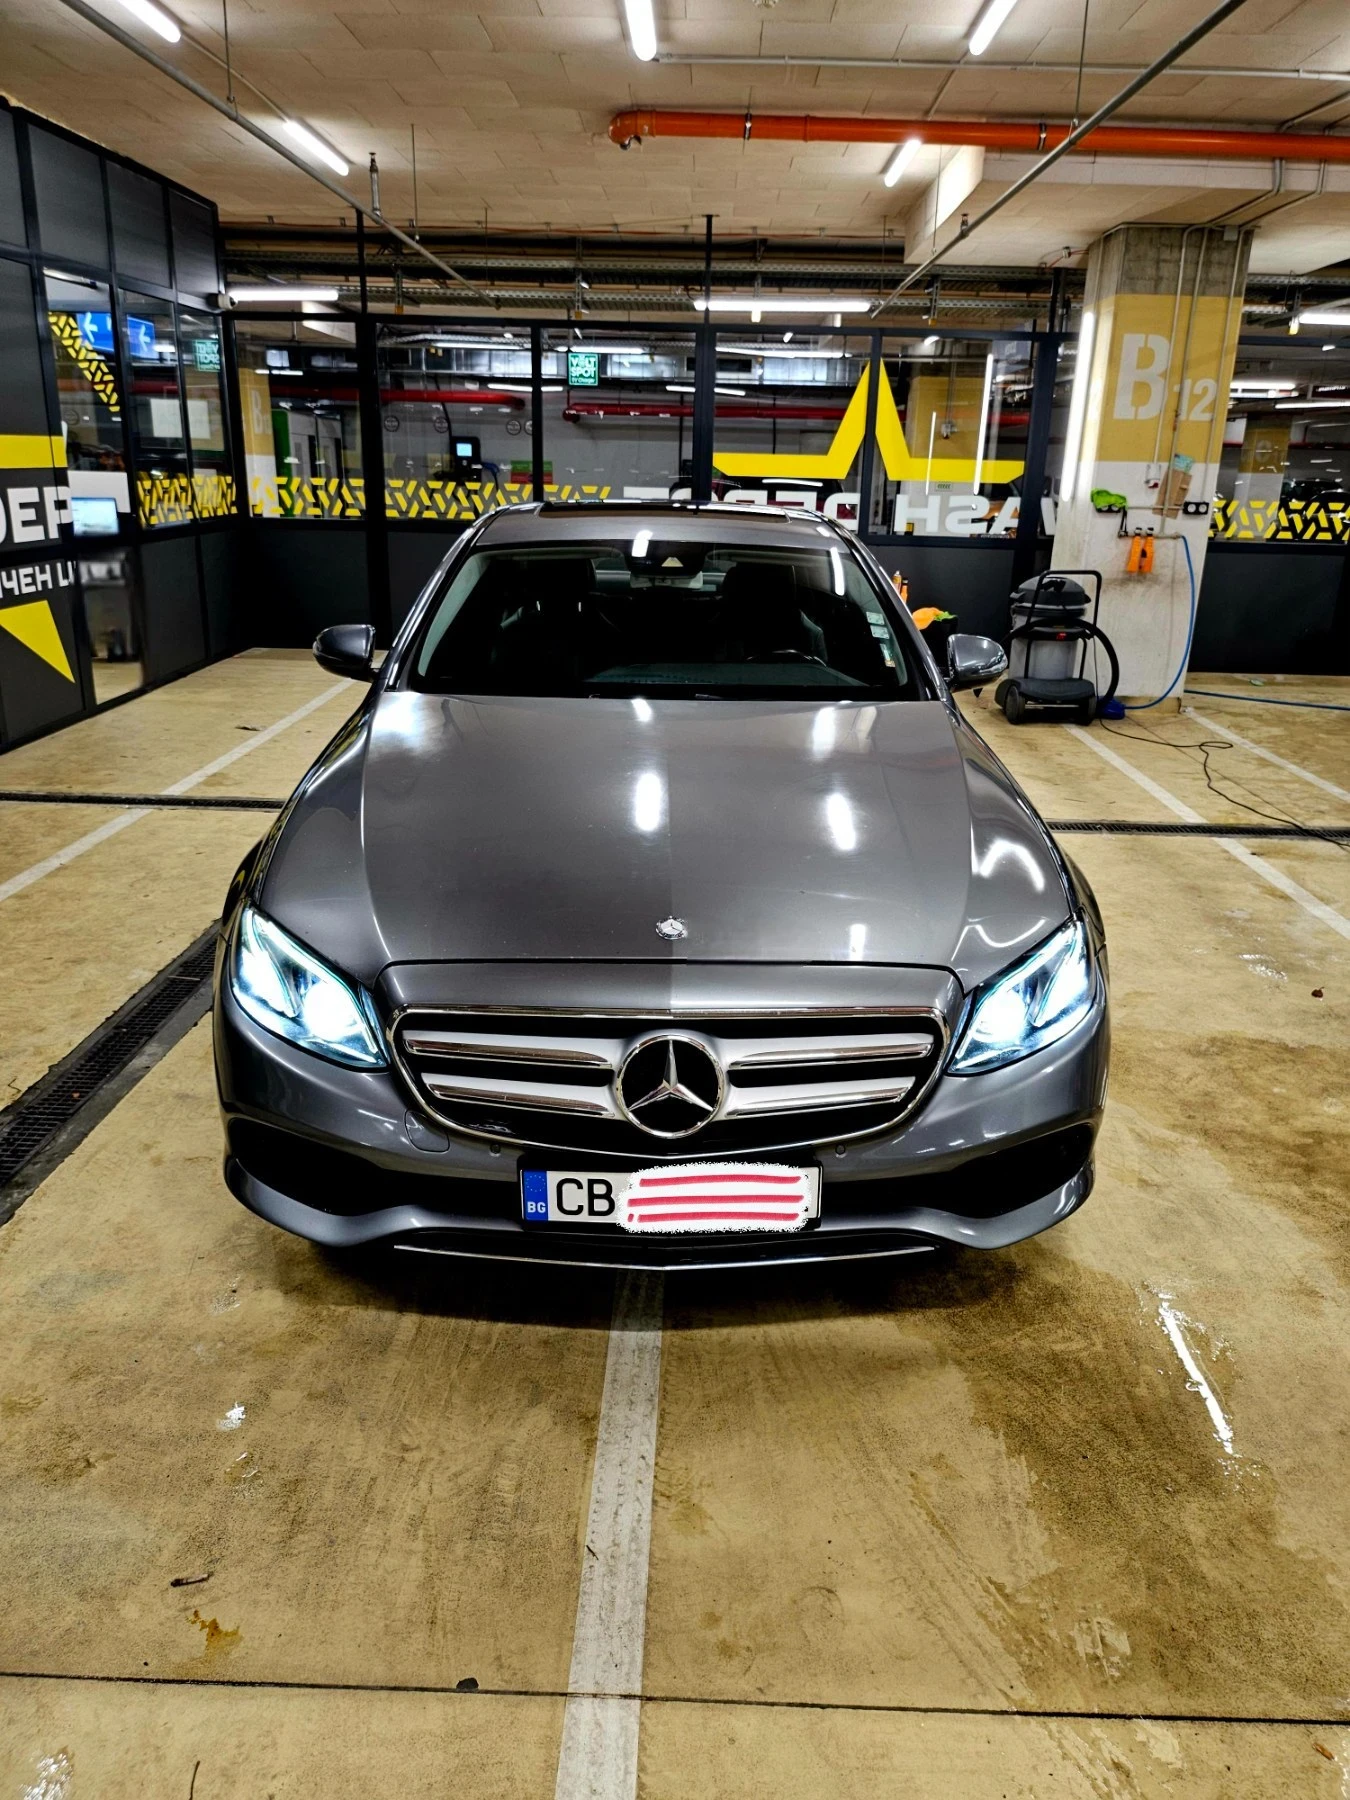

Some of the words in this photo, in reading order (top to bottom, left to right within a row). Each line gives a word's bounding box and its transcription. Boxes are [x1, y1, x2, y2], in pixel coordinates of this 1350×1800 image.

[570, 367, 597, 378] SPOT
[0, 564, 53, 599] ЧЕН
[527, 1201, 547, 1214] BG
[556, 1177, 616, 1217] CB
